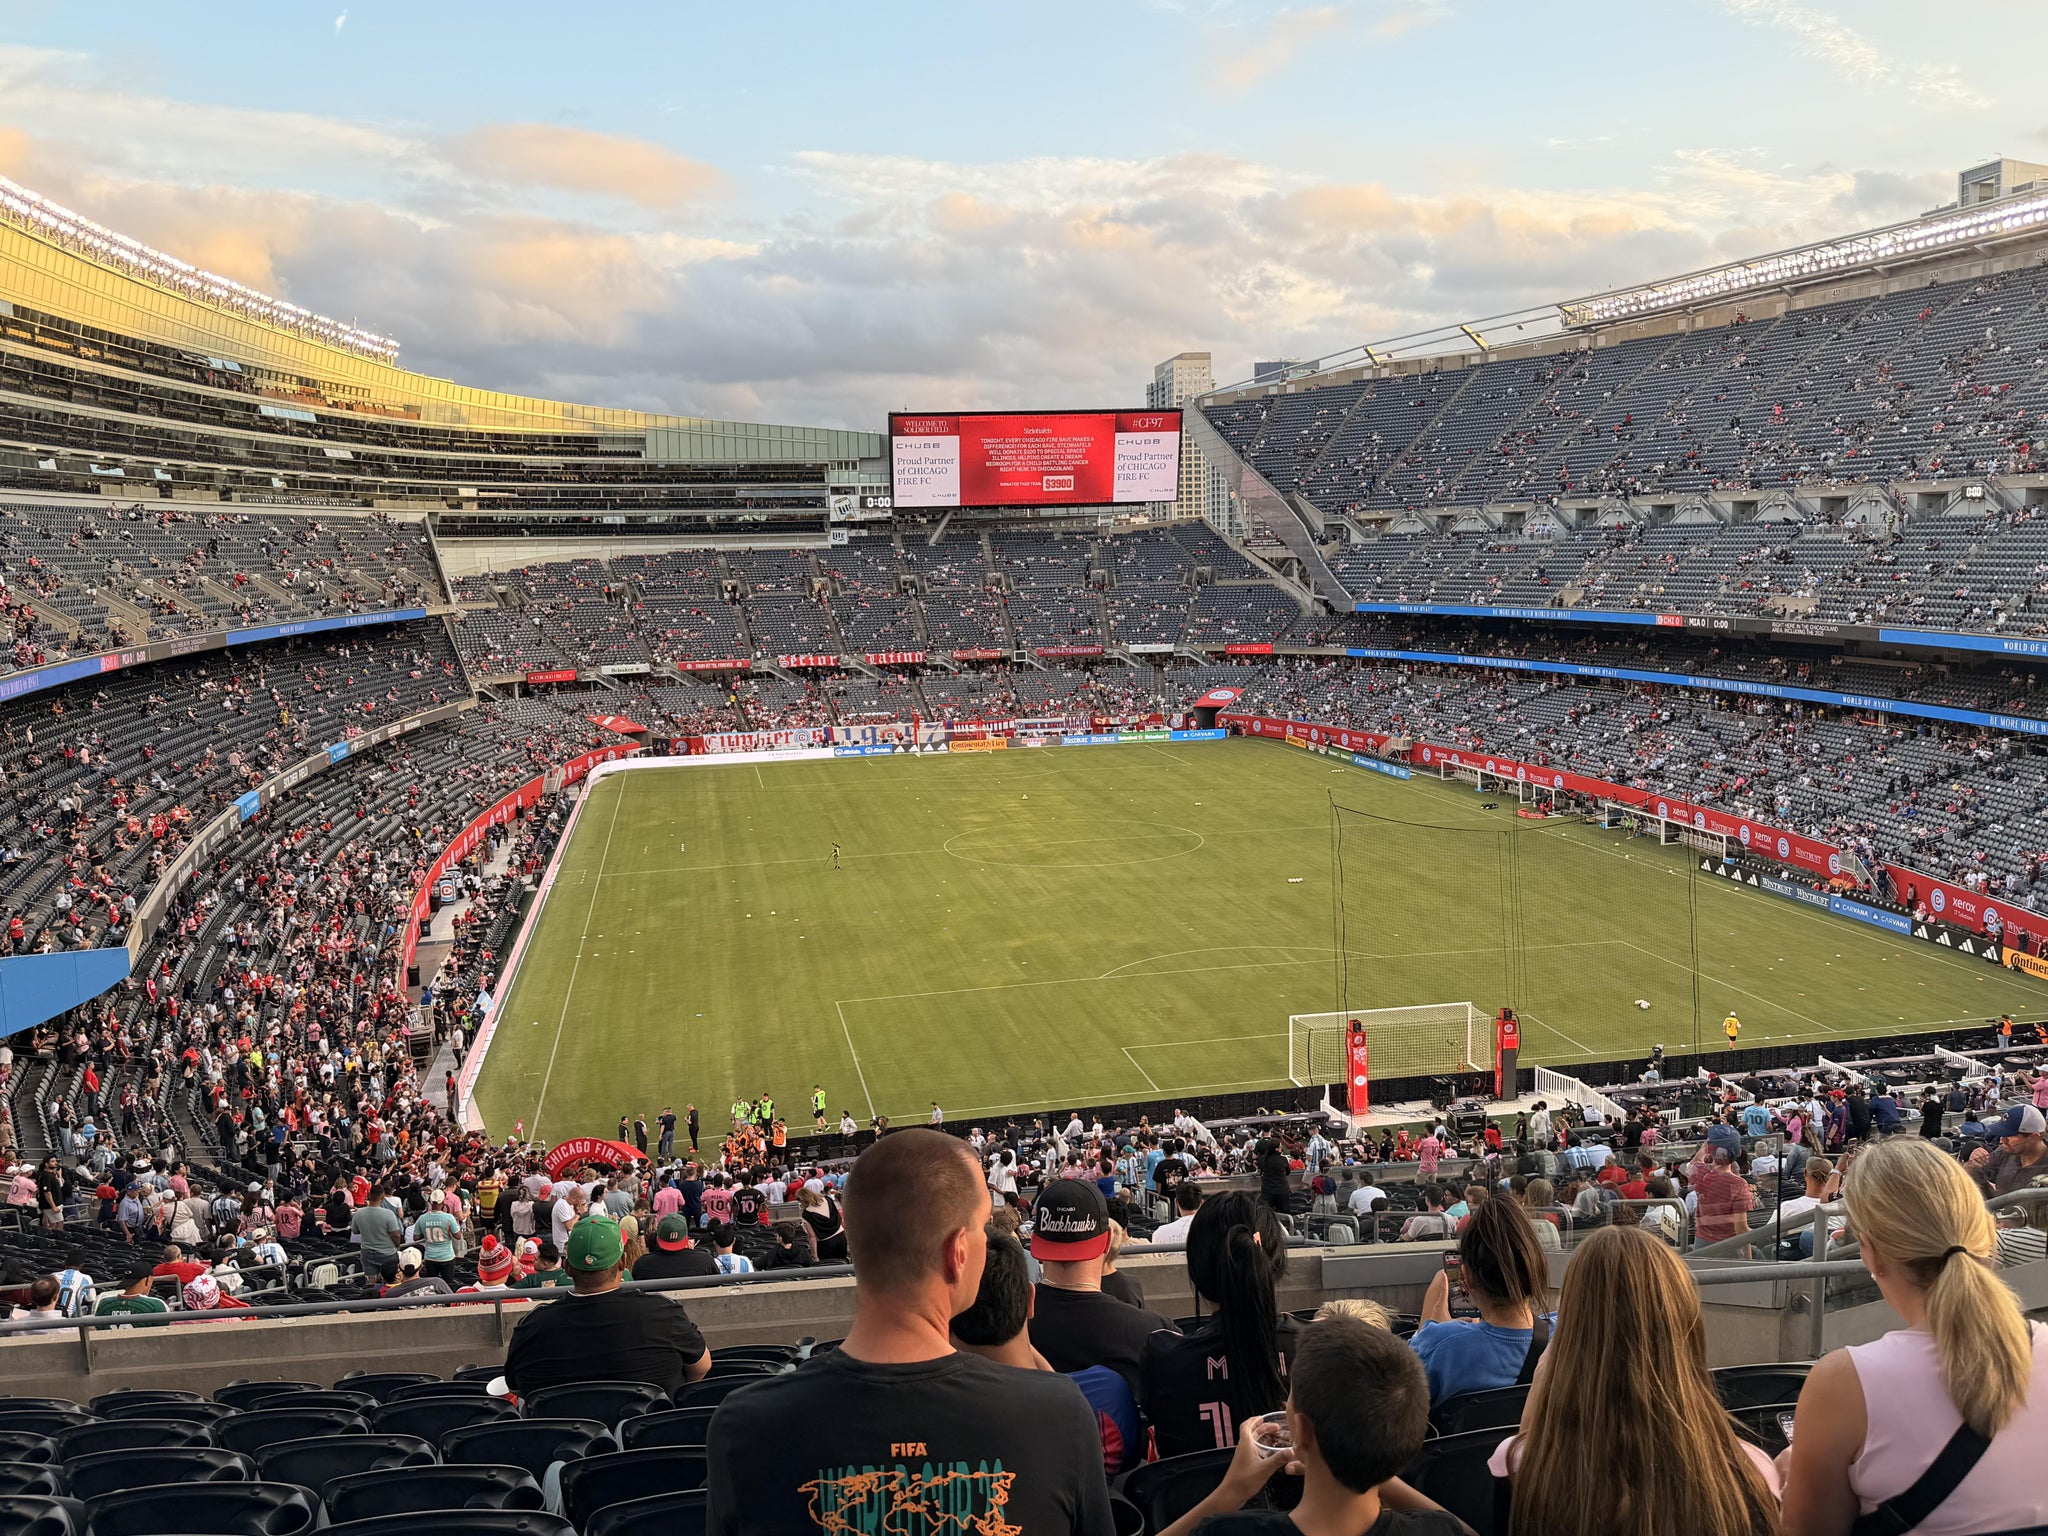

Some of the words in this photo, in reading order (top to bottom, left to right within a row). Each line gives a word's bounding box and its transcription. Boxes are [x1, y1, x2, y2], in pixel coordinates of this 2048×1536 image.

[1133, 418, 1163, 428] #CF97
[897, 457, 922, 465] Proud
[924, 457, 955, 465] Partner
[1118, 453, 1142, 461] Proud
[897, 467, 906, 475] of
[907, 467, 948, 475] CHICAGO
[1117, 463, 1126, 471] of
[1127, 463, 1167, 471] CHICAGO
[920, 477, 931, 485] FC
[1045, 478, 1072, 489] $3900
[1966, 487, 1982, 497] 0:00
[867, 496, 891, 508] 0:00
[1663, 617, 1675, 625] CHI
[1675, 617, 1680, 625] 0
[1689, 618, 1700, 627] MIA
[1701, 619, 1706, 627] 0
[1713, 620, 1729, 629] 0:00
[976, 649, 1000, 657] Burners
[2003, 642, 2028, 652] WORLD
[2030, 643, 2039, 653] OF
[1688, 677, 1694, 685] BE
[1696, 678, 1709, 686] MORE
[1710, 679, 1723, 688] HERE
[1724, 681, 1737, 690] WITH
[1738, 682, 1756, 692] WORLD
[1758, 685, 1765, 693] OF
[1766, 685, 1782, 696] HYATT
[1842, 696, 1863, 706] WORLD
[1864, 697, 1871, 706] OF
[1873, 698, 1893, 709] HYATT
[1989, 715, 1997, 726] BE
[2000, 717, 2018, 729] MORE
[2020, 720, 2038, 732] HERE
[951, 740, 986, 750] Continental
[991, 739, 1005, 748] Tire
[1672, 807, 1688, 818] xerox
[1710, 820, 1735, 835] WINTRUST
[1754, 832, 1772, 844] xerox
[1795, 846, 1822, 864] WINTRUST
[1762, 877, 1792, 896] WINTRUST
[1796, 888, 1829, 907] WINTRUST
[1842, 903, 1869, 918] CARVANA
[1952, 897, 1977, 914] xerox
[1880, 914, 1909, 929] CARVANA
[1958, 911, 1974, 922] Solutions
[1750, 1115, 1763, 1125] 10
[544, 1140, 591, 1171] CHICAGO
[595, 1140, 622, 1164] FIRE
[1576, 1154, 1588, 1166] 10
[710, 1200, 725, 1211] 10
[740, 1200, 755, 1213] 10
[281, 1213, 289, 1224] 12
[1040, 1206, 1097, 1233] Blackhawks
[1663, 1215, 1676, 1231] 254
[425, 1227, 444, 1243] 10
[890, 1442, 928, 1457] FIFA
